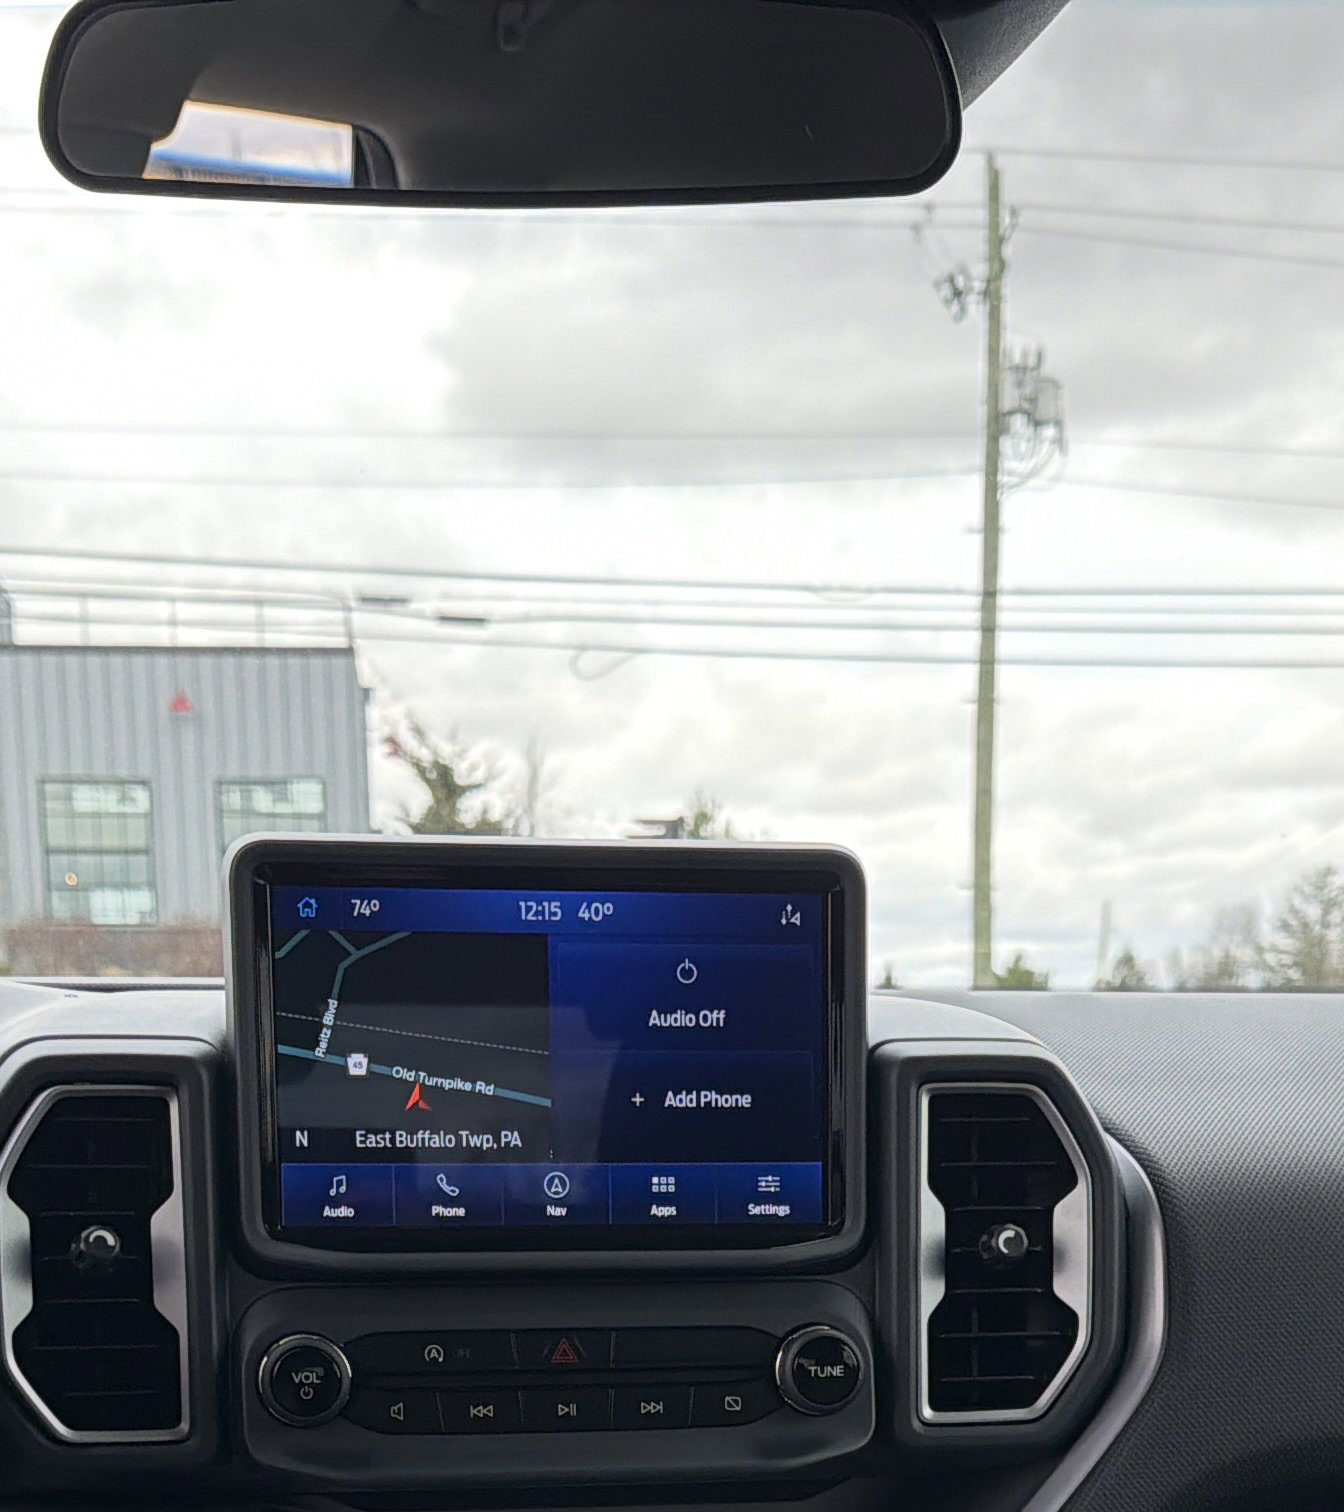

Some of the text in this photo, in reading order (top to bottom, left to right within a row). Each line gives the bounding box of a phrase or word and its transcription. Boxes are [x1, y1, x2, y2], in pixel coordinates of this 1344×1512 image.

[519, 901, 562, 922] 12:15
[648, 1008, 725, 1028] Audio Off
[315, 999, 338, 1058] Reitz Blvd
[391, 1065, 496, 1096] Old Turnpike Rd
[664, 1090, 752, 1109] Add Phone
[294, 1131, 309, 1148] N
[355, 1130, 523, 1152] East Buffalo Twp, PA
[322, 1205, 355, 1218] Audio
[431, 1205, 466, 1218] Phone
[545, 1204, 567, 1217] Nav
[649, 1204, 677, 1220] Apps
[747, 1202, 791, 1219] Settings
[292, 1371, 321, 1385] VOL
[808, 1364, 845, 1378] TUNE
